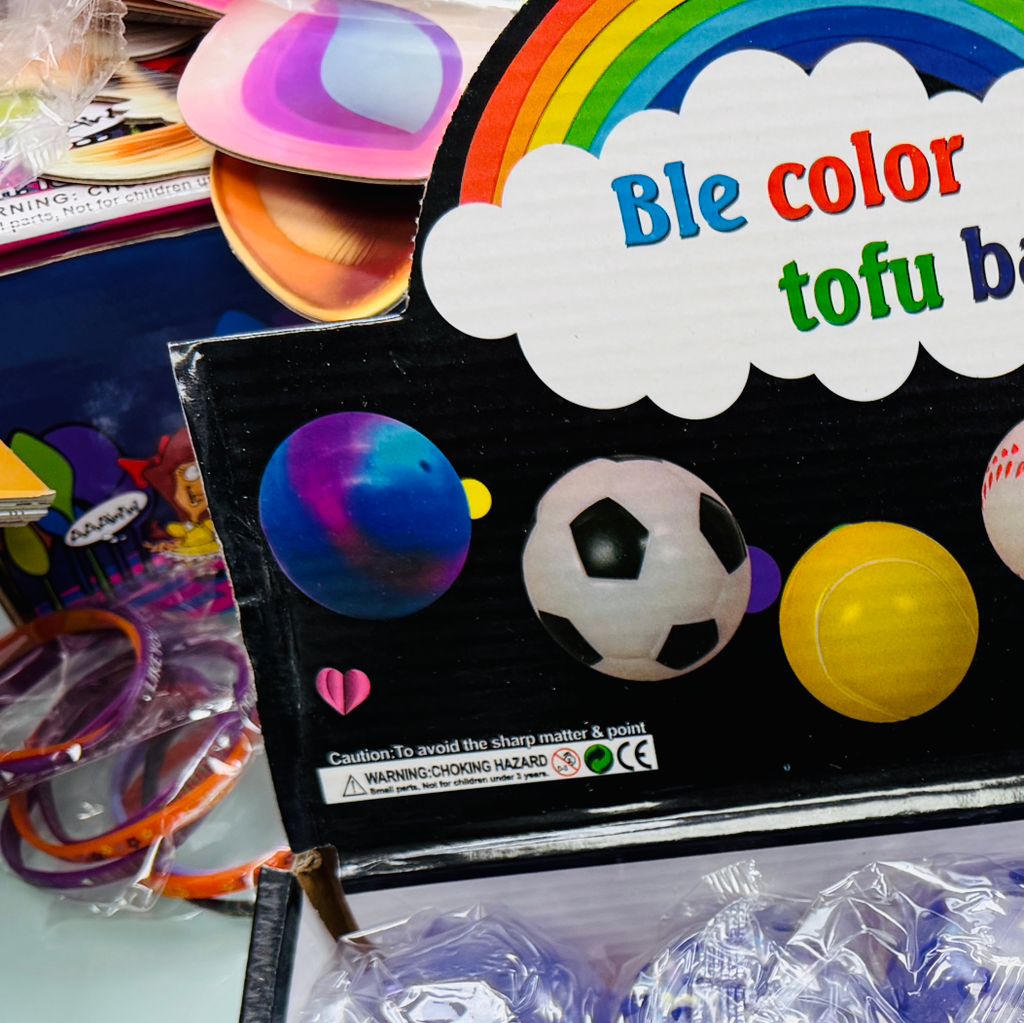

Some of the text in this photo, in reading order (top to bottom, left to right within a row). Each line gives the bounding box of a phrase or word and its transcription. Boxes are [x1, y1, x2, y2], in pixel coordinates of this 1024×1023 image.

[62, 200, 93, 216] Not
[96, 196, 119, 209] for
[125, 181, 192, 203] children
[611, 130, 965, 248] Ble color
[778, 240, 944, 333] tofu
[417, 738, 460, 757] avoid
[462, 737, 488, 751] the
[492, 734, 536, 750] sharp
[539, 728, 588, 744] matter
[591, 725, 605, 738] &
[607, 721, 648, 741] point
[494, 754, 548, 773] HAZARD
